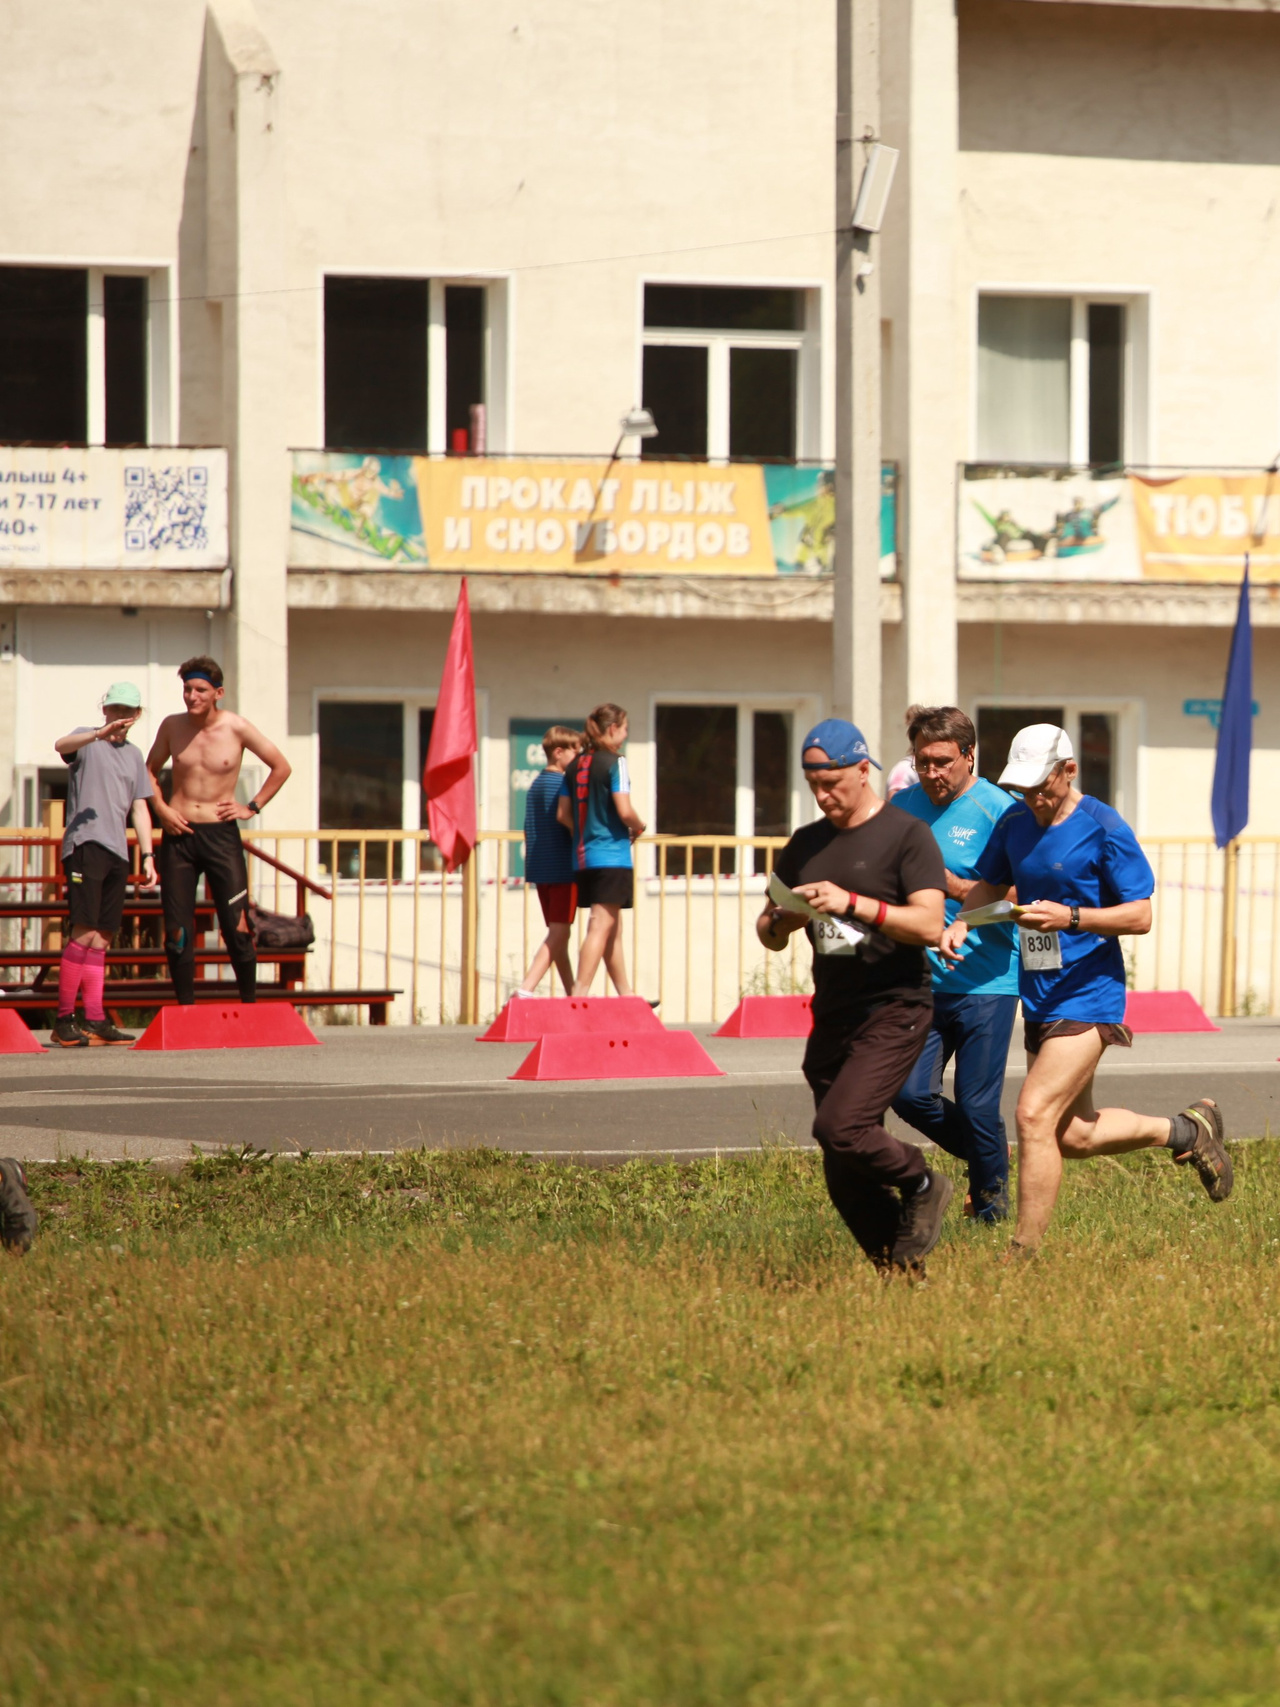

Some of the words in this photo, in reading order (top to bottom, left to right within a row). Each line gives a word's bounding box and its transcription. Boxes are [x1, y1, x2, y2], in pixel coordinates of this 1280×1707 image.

[0, 471, 56, 484] лыш
[62, 467, 87, 484] 4+
[16, 493, 57, 510] 7-17
[63, 498, 101, 511] лет
[462, 476, 620, 512] ПРОКАТ
[630, 479, 736, 514] ЛЫЖ
[444, 517, 471, 552] И
[485, 517, 750, 562] СНОУБОРДОВ
[1027, 935, 1052, 952] 830
